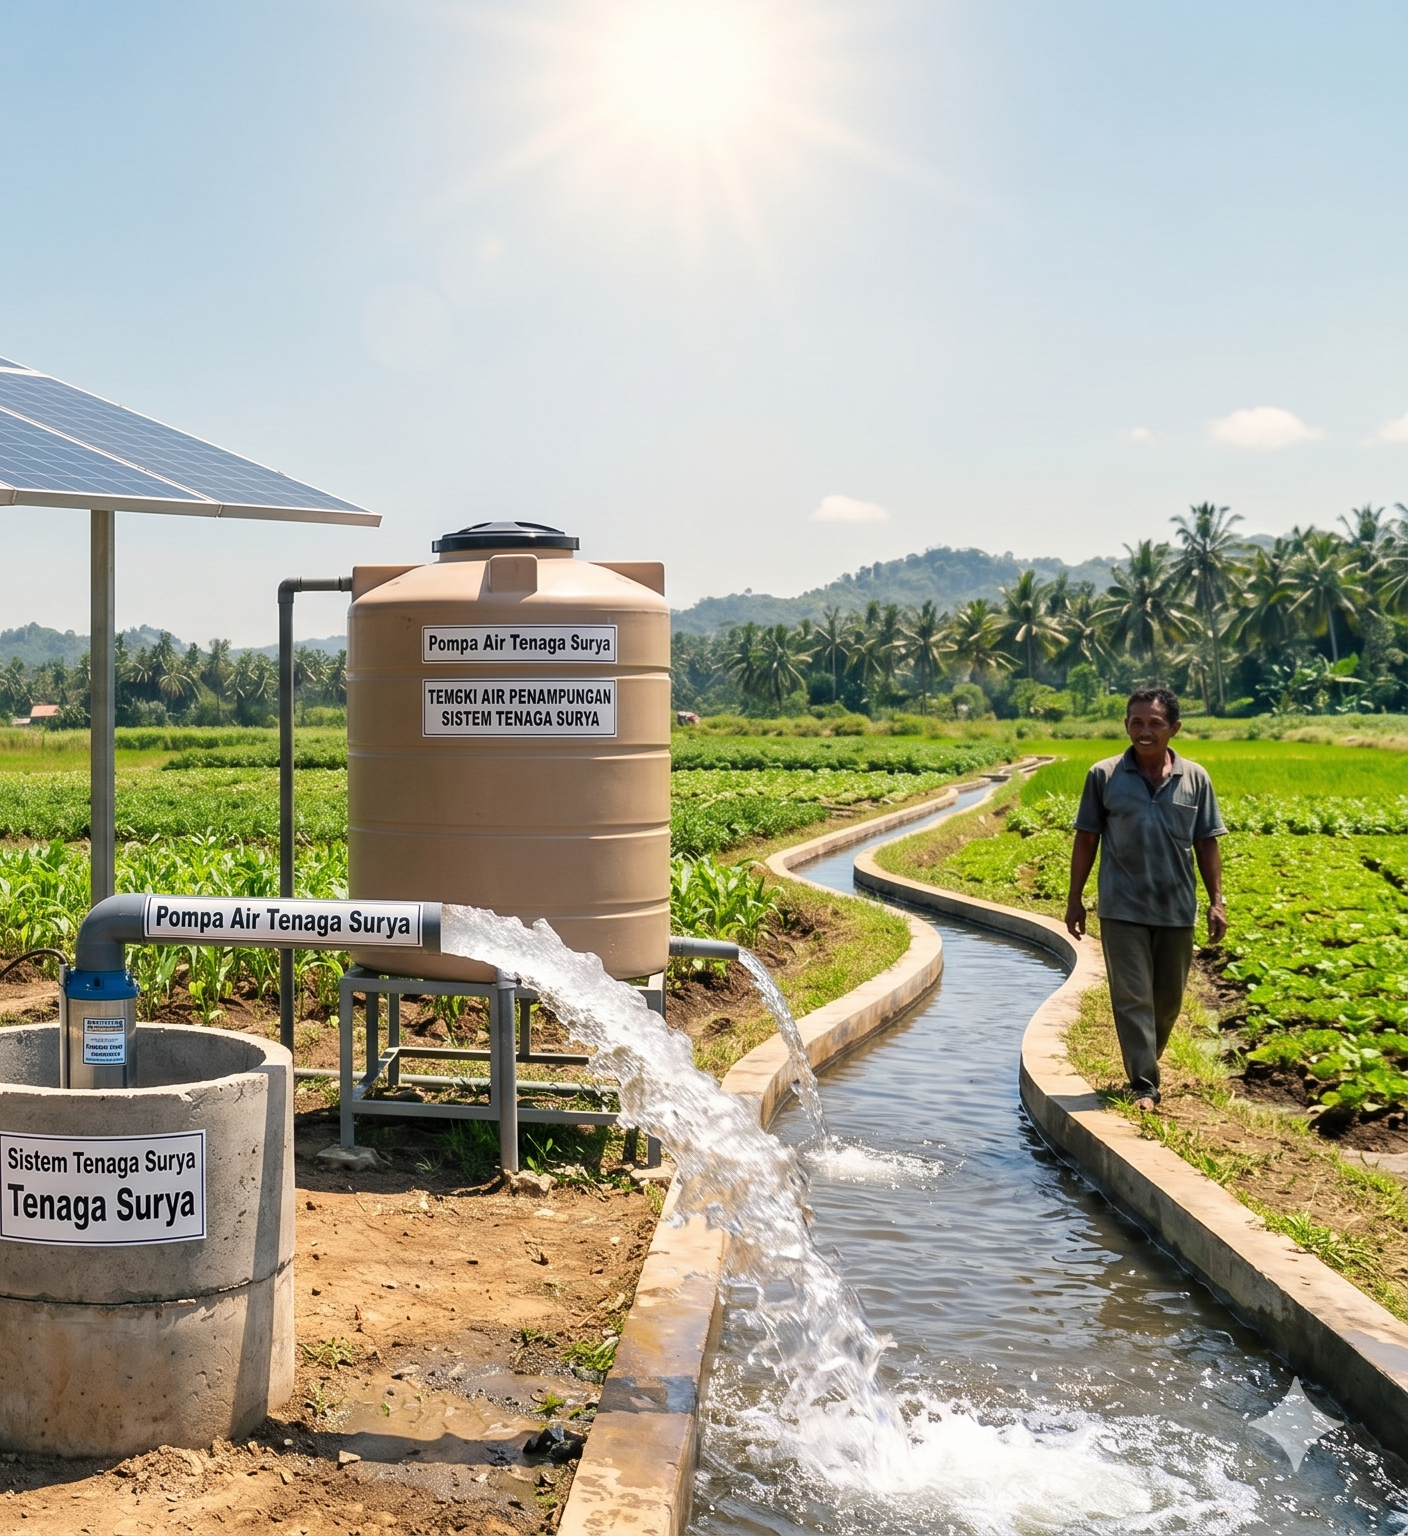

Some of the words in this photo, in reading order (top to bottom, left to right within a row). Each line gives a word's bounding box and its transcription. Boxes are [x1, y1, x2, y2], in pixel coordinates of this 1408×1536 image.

[428, 634, 479, 656] Pompa
[482, 633, 506, 651] Air
[509, 633, 566, 655] Tenaga
[570, 633, 611, 656] Surya
[480, 688, 506, 705] AIR
[509, 688, 611, 705] PENAMPUNGAN
[441, 710, 492, 727] SISTEM
[495, 710, 553, 727] TENAGA
[556, 710, 600, 727] SURYA
[156, 905, 224, 934] Pompa
[229, 907, 261, 930] Air
[266, 908, 342, 938] Tenaga
[348, 910, 411, 940] Surya
[7, 1147, 68, 1174] Sistem
[72, 1151, 140, 1180] Tenaga
[144, 1149, 196, 1176] Surya
[7, 1182, 107, 1231] Tenaga
[116, 1187, 195, 1229] Surya
